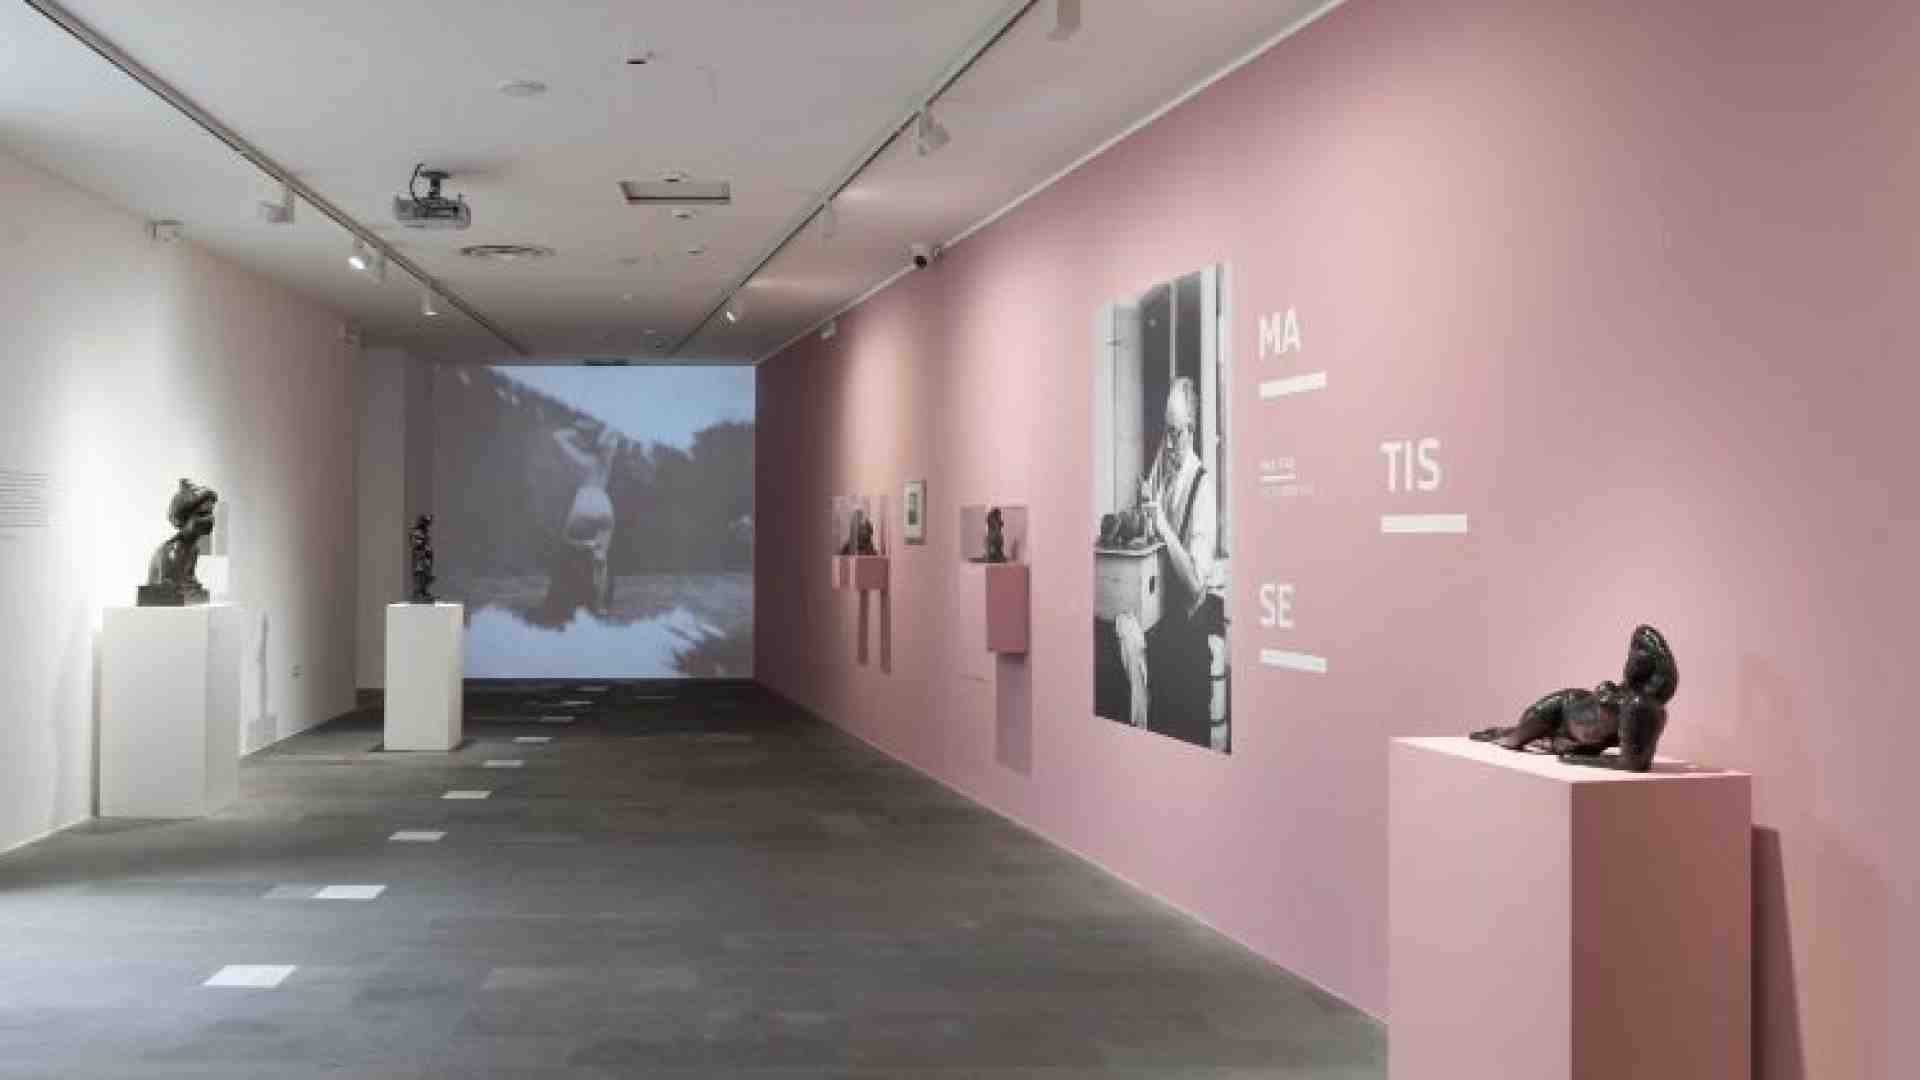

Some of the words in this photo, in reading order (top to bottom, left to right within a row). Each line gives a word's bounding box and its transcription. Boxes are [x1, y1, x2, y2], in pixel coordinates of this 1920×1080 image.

[1259, 307, 1301, 359] MA
[1379, 438, 1441, 492] TIS
[1259, 583, 1294, 628] SE
